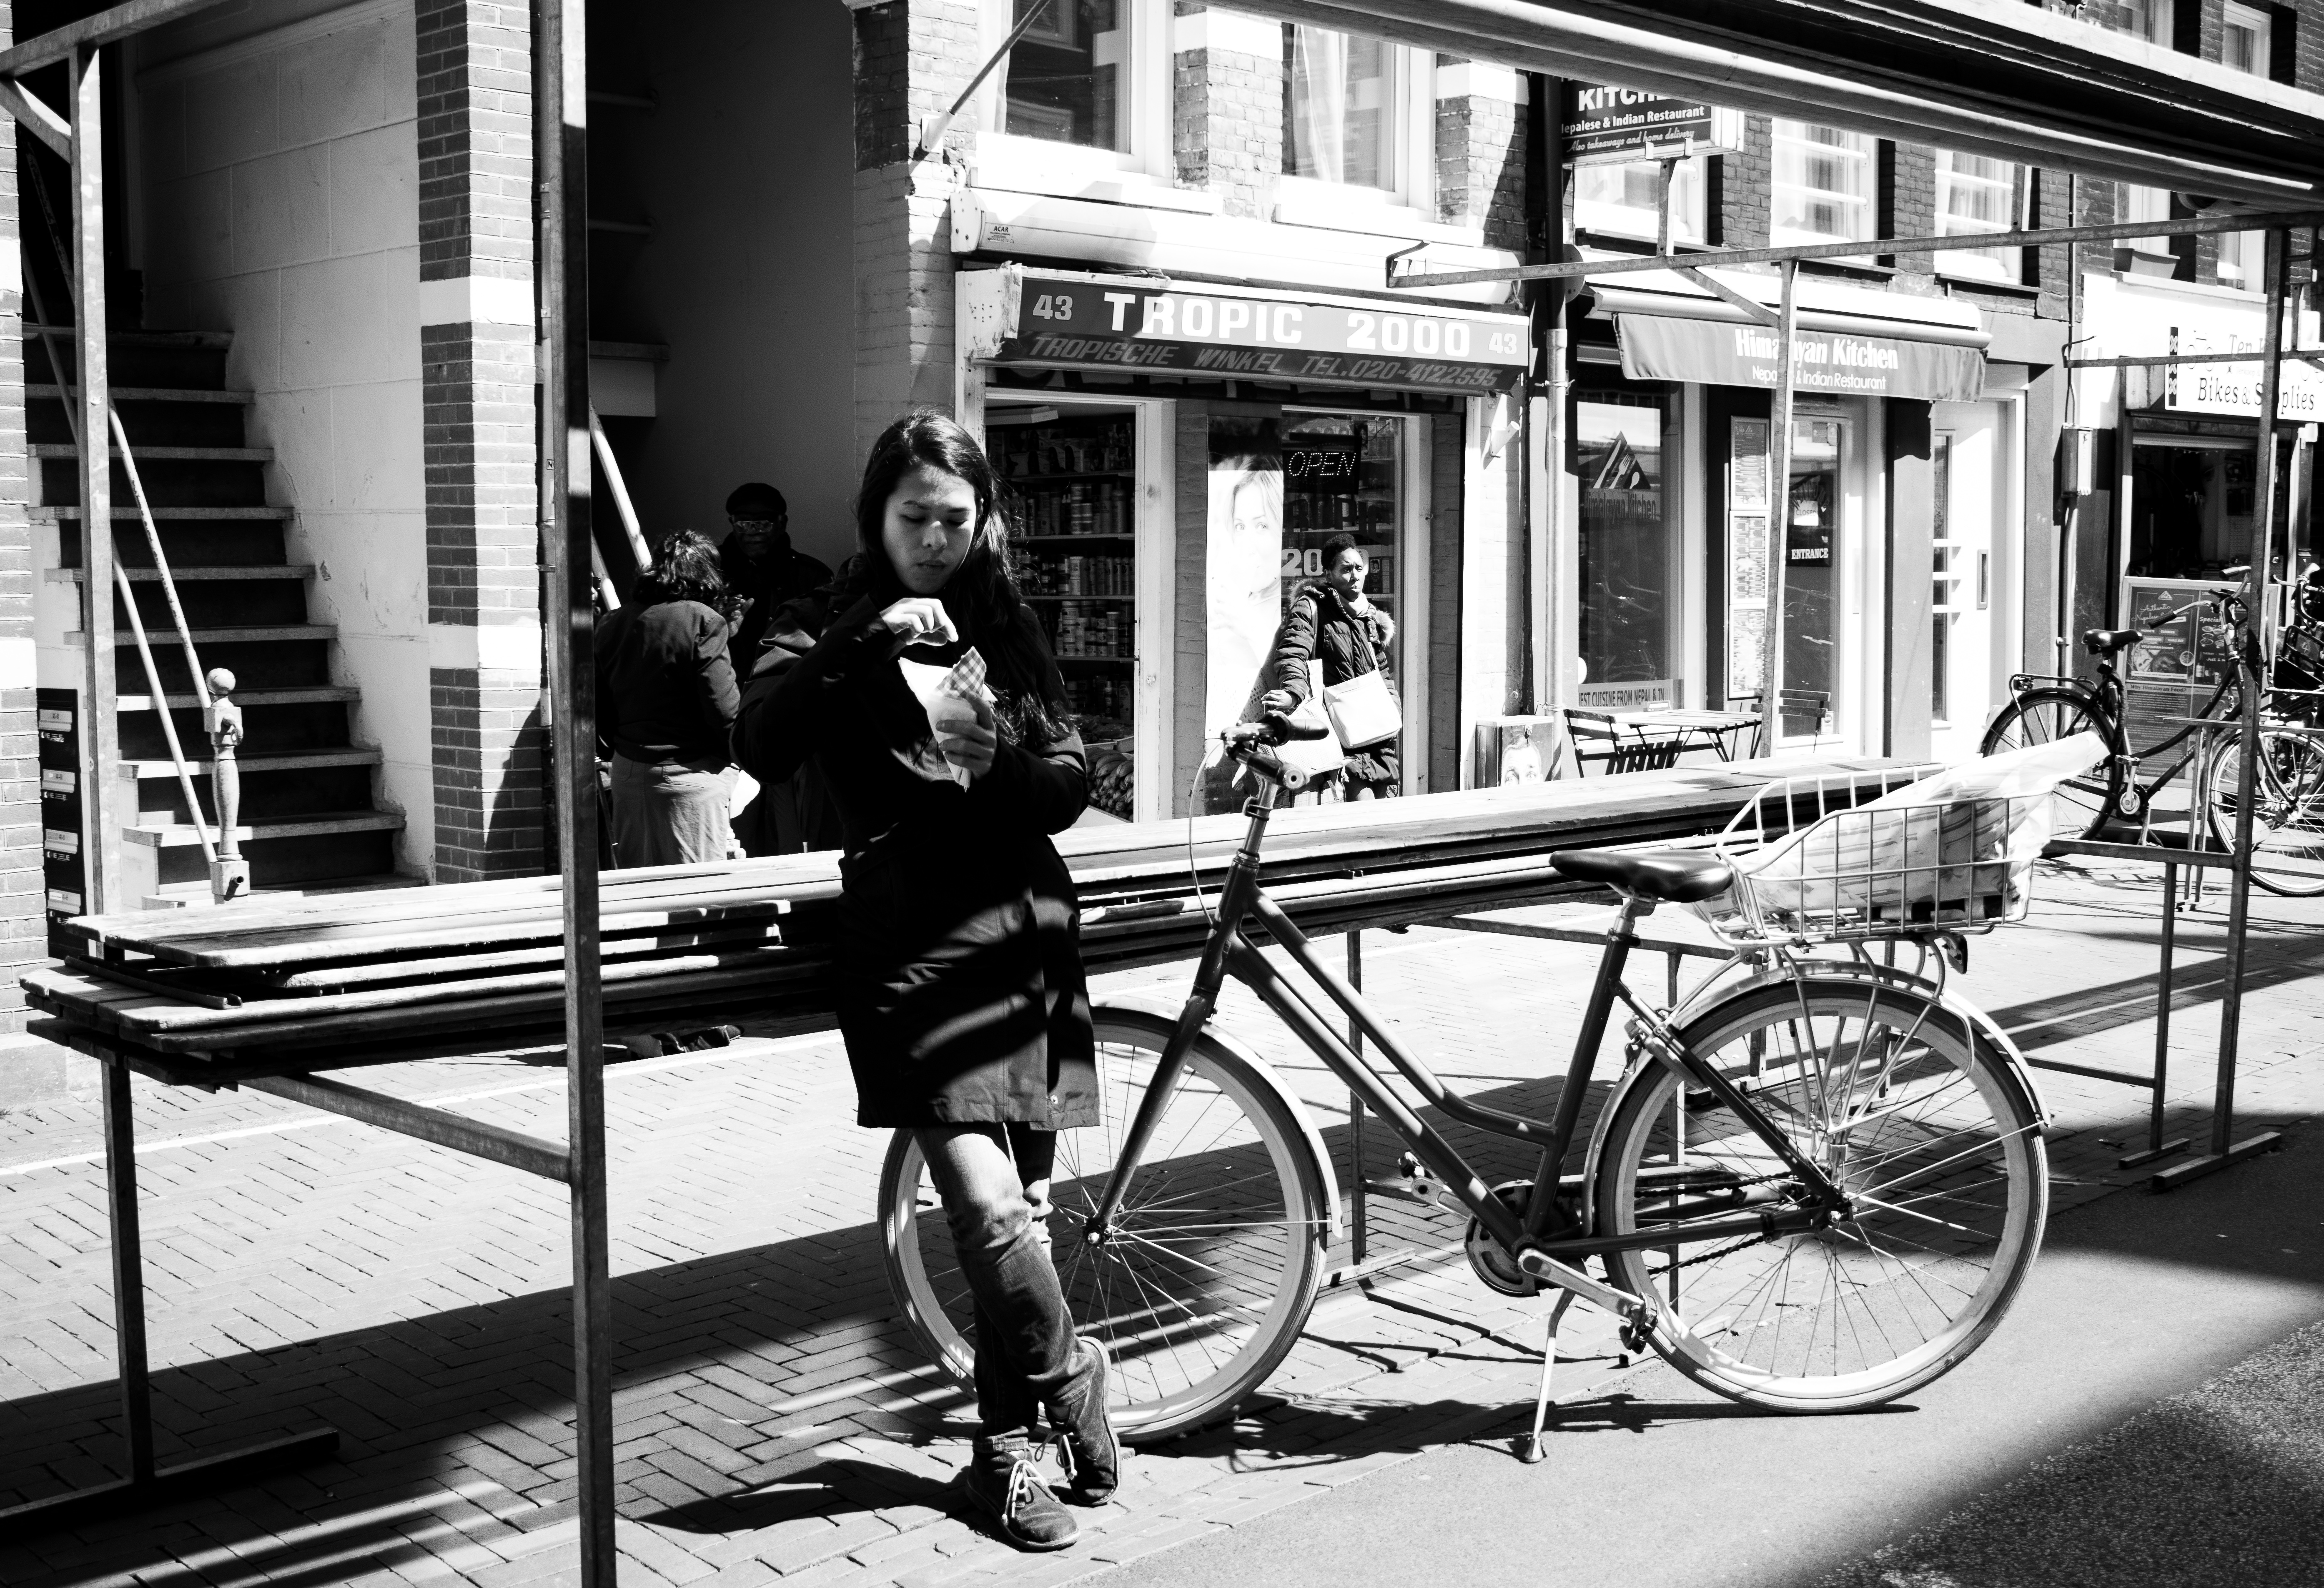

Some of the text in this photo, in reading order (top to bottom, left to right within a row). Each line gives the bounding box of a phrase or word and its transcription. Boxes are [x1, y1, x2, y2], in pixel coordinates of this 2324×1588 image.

[1602, 117, 1611, 128] &
[1613, 114, 1645, 127] Indian
[1647, 106, 1705, 122] Restaurant
[1567, 127, 1695, 153] Also takeaways and home delivery
[1033, 292, 1517, 357] 43 TROPIC 2000 43
[1029, 336, 1179, 365] TROPISCHE
[1193, 348, 1284, 372] WINKEL
[1735, 328, 1898, 369] Himayan Kitchen
[1796, 370, 1802, 384] &
[1803, 370, 1833, 387] Indian
[1834, 373, 1886, 390] Restaurant
[2198, 377, 2314, 415] Bikes & Splies
[1288, 451, 1356, 476] OPEN
[1584, 490, 1657, 524] Himalayan Kitchen
[1792, 548, 1829, 560] ENTRANCE
[1592, 691, 1615, 707] CUISINE
[1617, 690, 1632, 706] FROM
